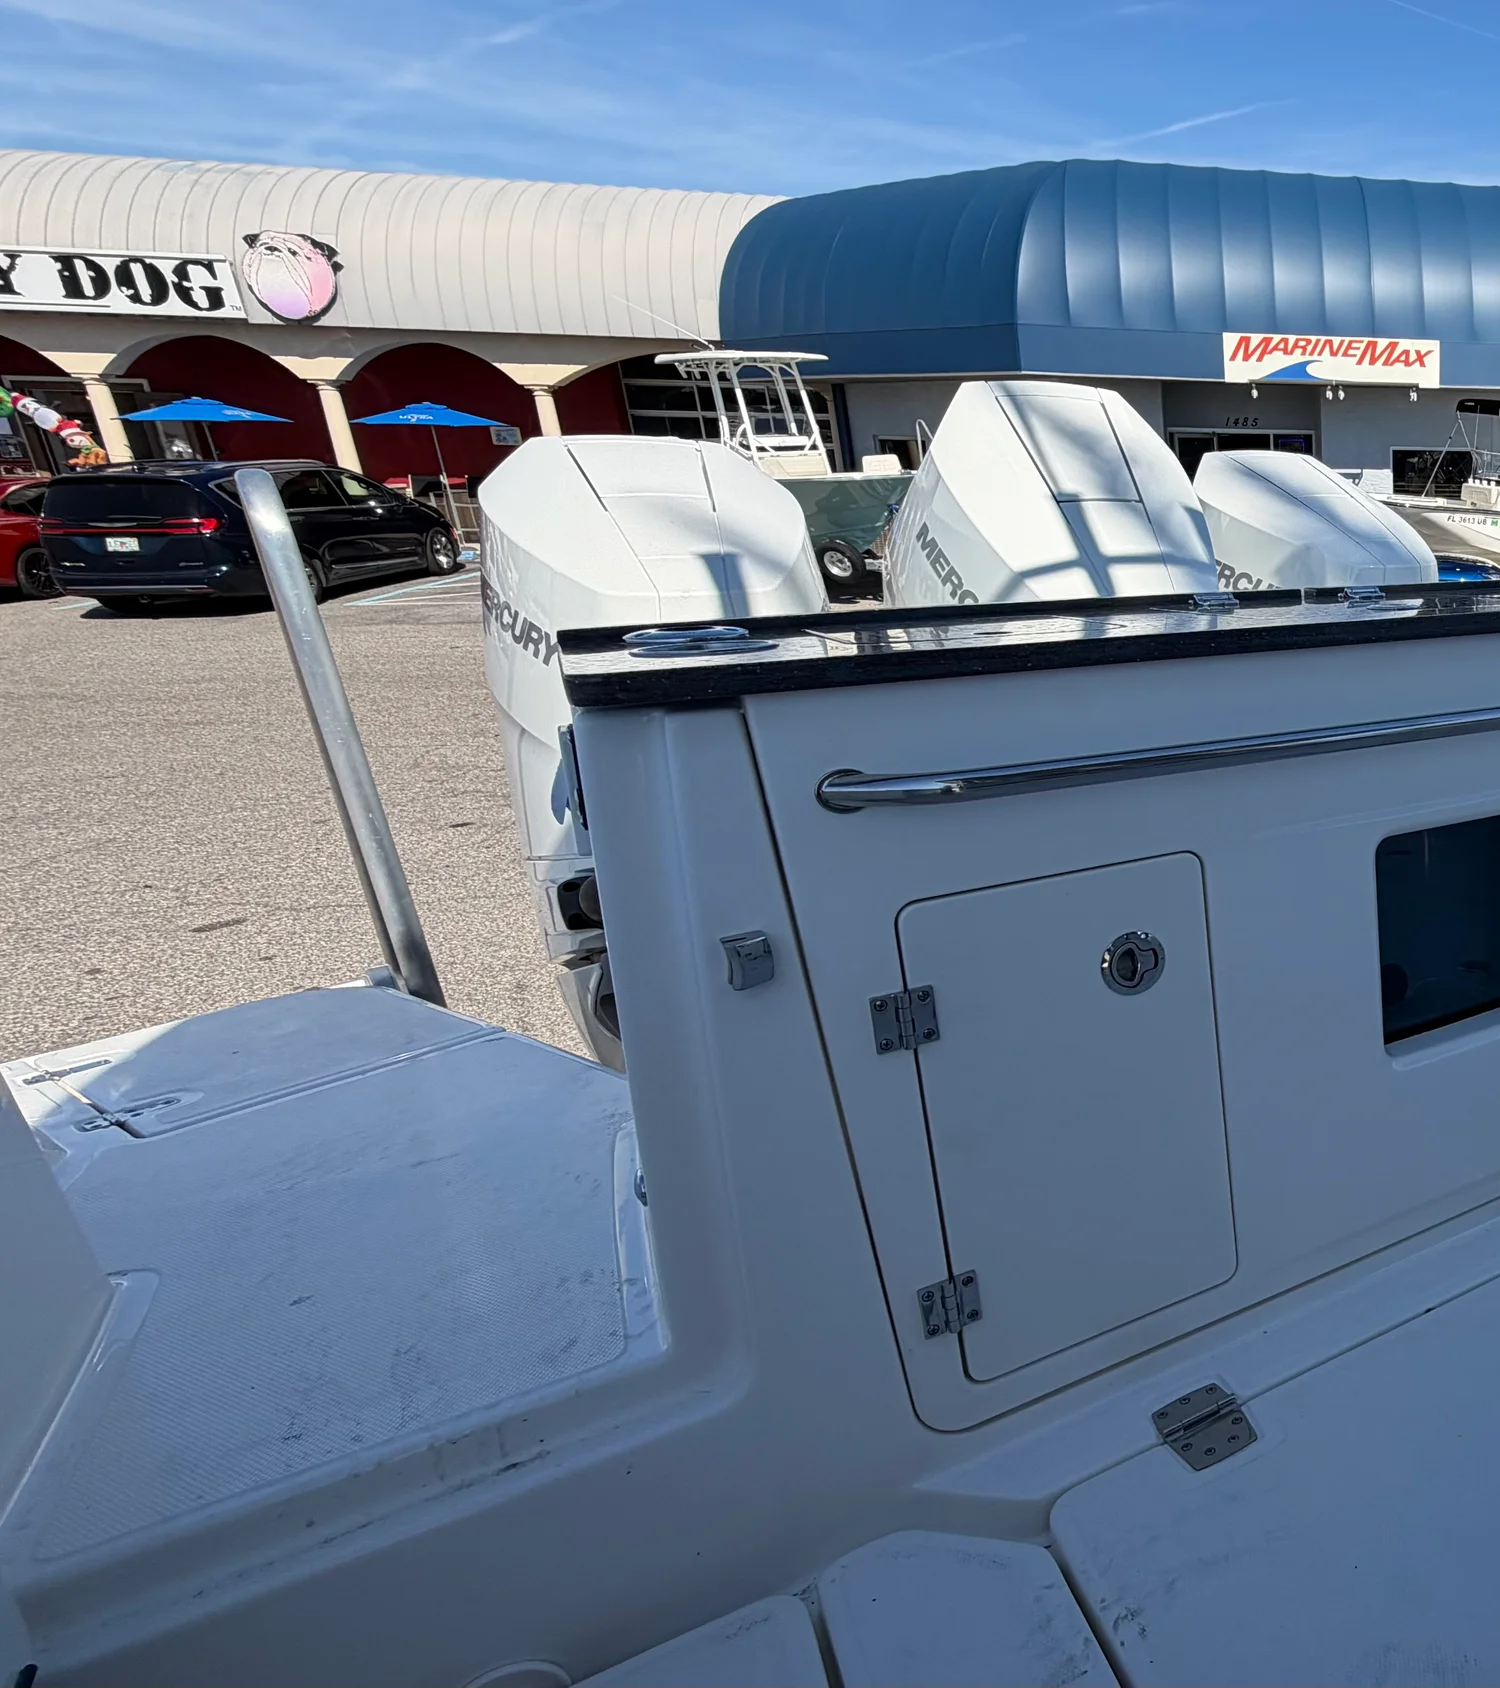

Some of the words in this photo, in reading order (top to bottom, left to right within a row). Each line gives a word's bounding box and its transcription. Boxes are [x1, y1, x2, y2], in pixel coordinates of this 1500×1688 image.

[48, 254, 227, 313] DOG
[1225, 416, 1259, 428] 1485
[1458, 516, 1475, 525] 3613
